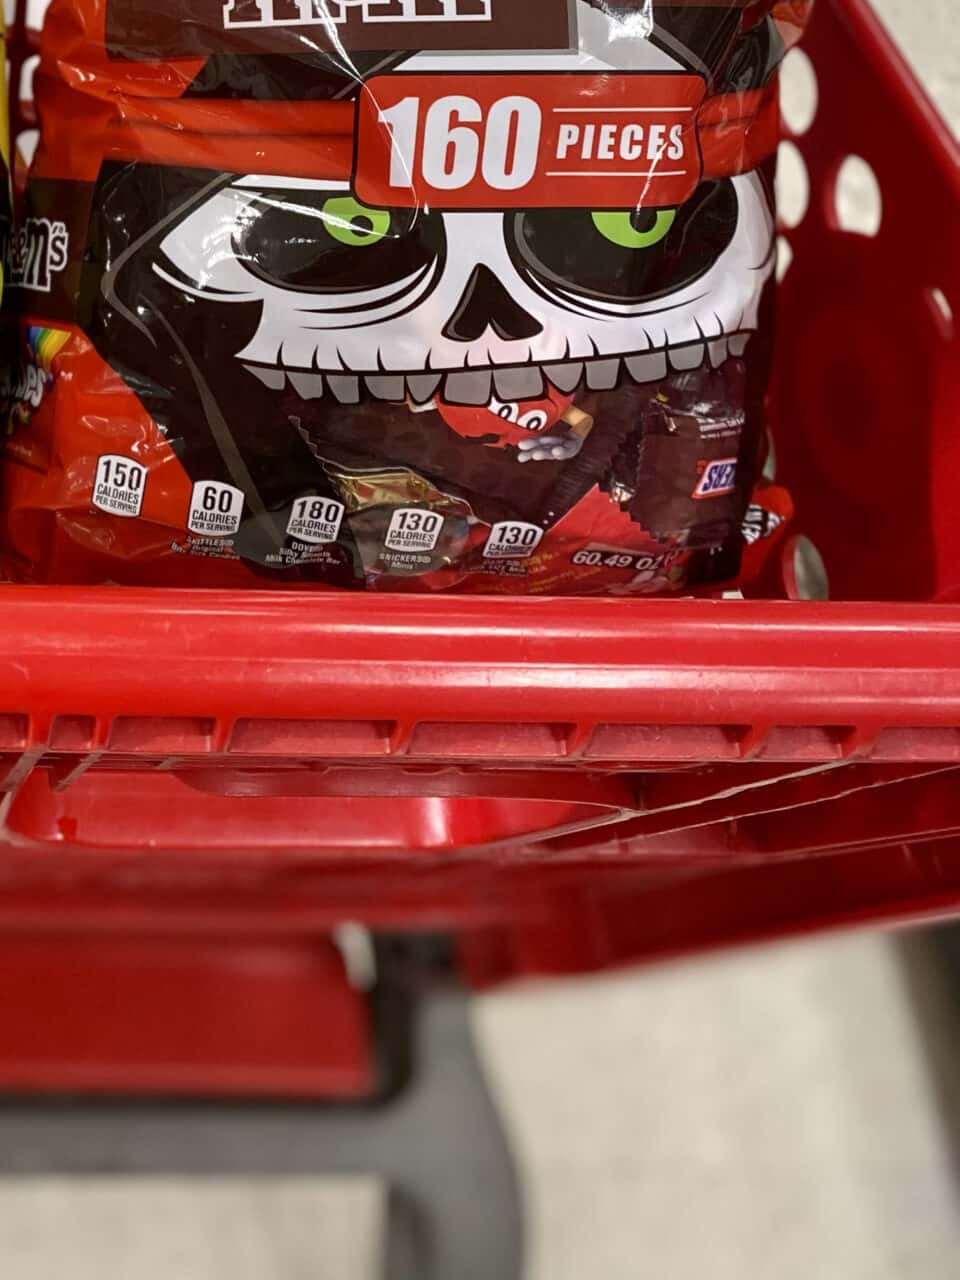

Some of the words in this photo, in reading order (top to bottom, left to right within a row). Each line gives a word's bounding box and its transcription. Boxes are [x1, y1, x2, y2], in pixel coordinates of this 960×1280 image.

[377, 95, 542, 190] 160
[555, 123, 685, 161] PIECES
[102, 459, 142, 491] 150
[96, 483, 140, 505] CALORIES
[202, 486, 233, 513] 60
[95, 495, 109, 506] PER
[109, 498, 138, 515] SERVING
[297, 500, 340, 523] 180
[190, 520, 205, 530] PER
[206, 522, 236, 532] SERVING
[191, 509, 238, 525] CALORIES
[290, 519, 337, 534] CALORIES
[398, 512, 438, 533] 130
[390, 531, 435, 543] CALORIES
[497, 525, 538, 546] 130
[573, 550, 633, 569] 60.49
